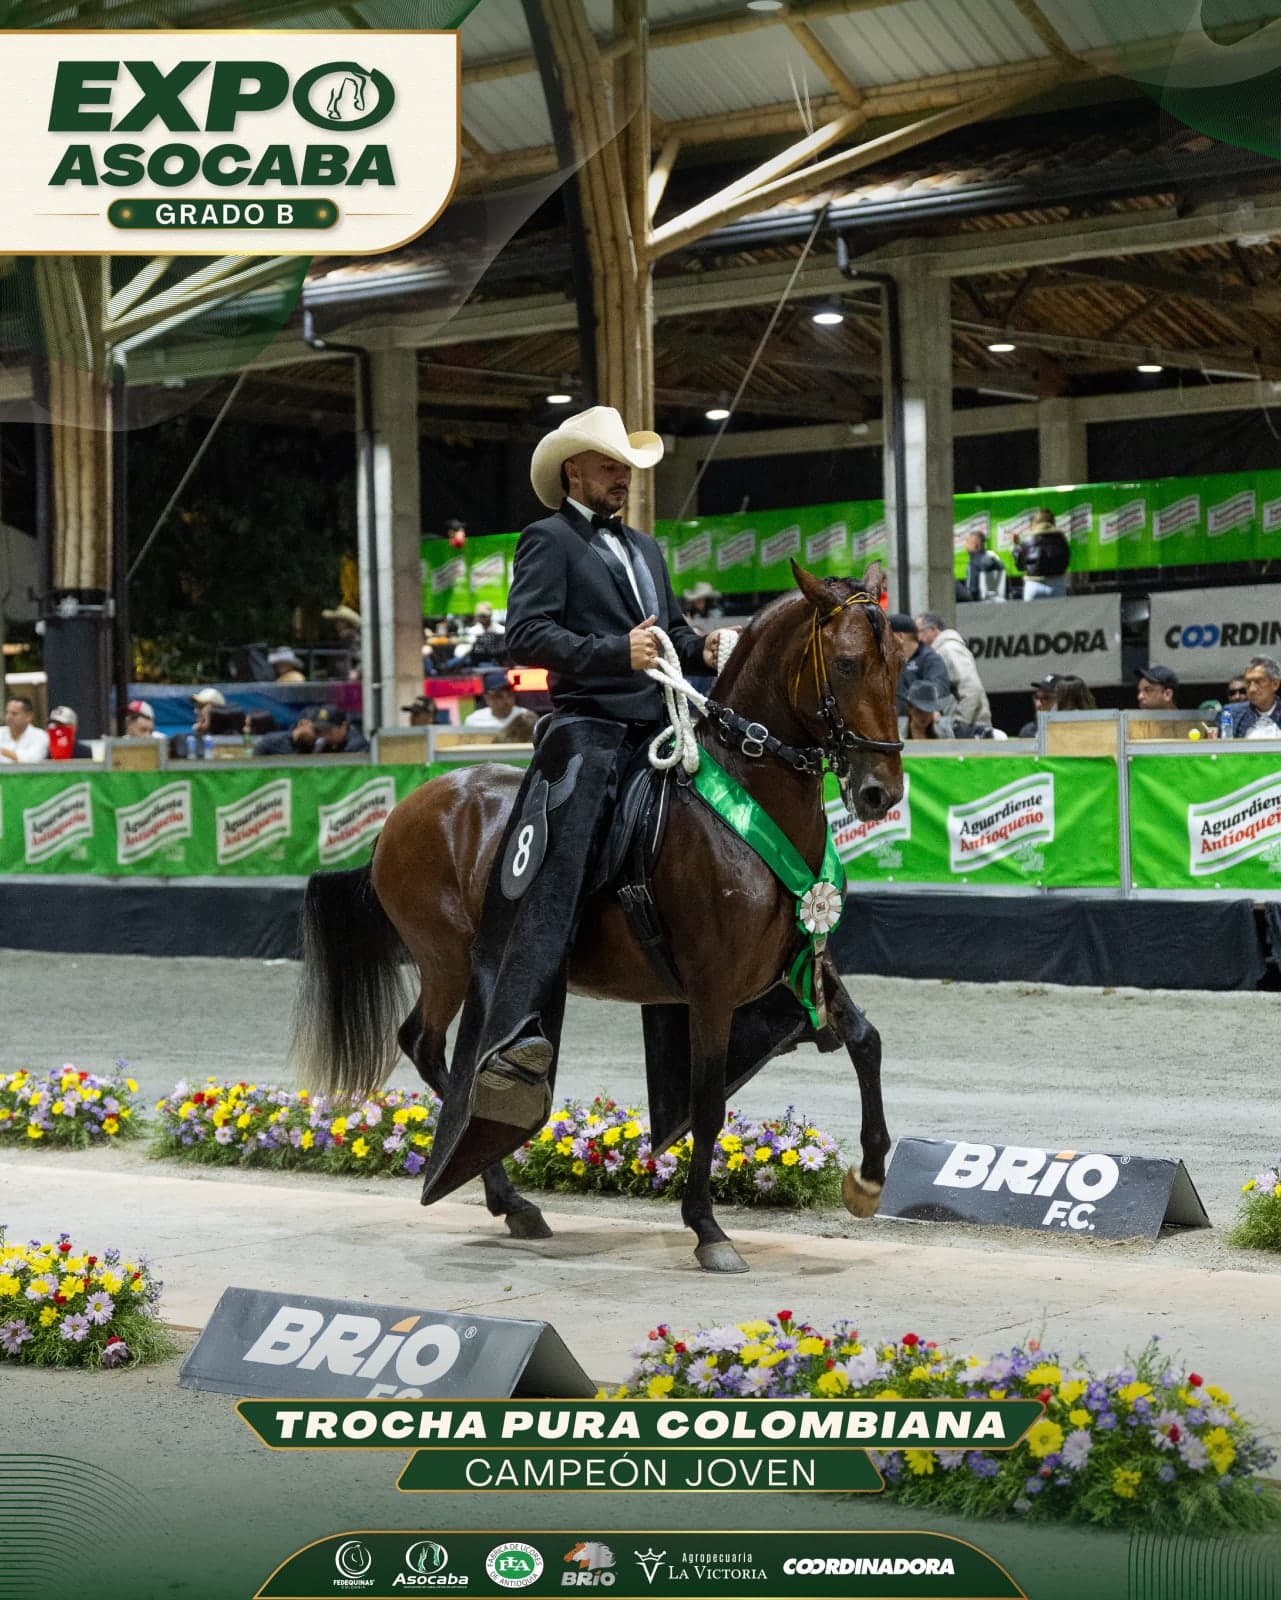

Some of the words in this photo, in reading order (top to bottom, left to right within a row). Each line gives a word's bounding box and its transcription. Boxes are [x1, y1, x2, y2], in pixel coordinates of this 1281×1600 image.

[965, 629, 1108, 659] DINADORA
[960, 795, 1042, 836] Aguardiente
[960, 809, 1044, 852] Antioqueño
[512, 824, 534, 877] 8
[1042, 1200, 1096, 1230] F.C.
